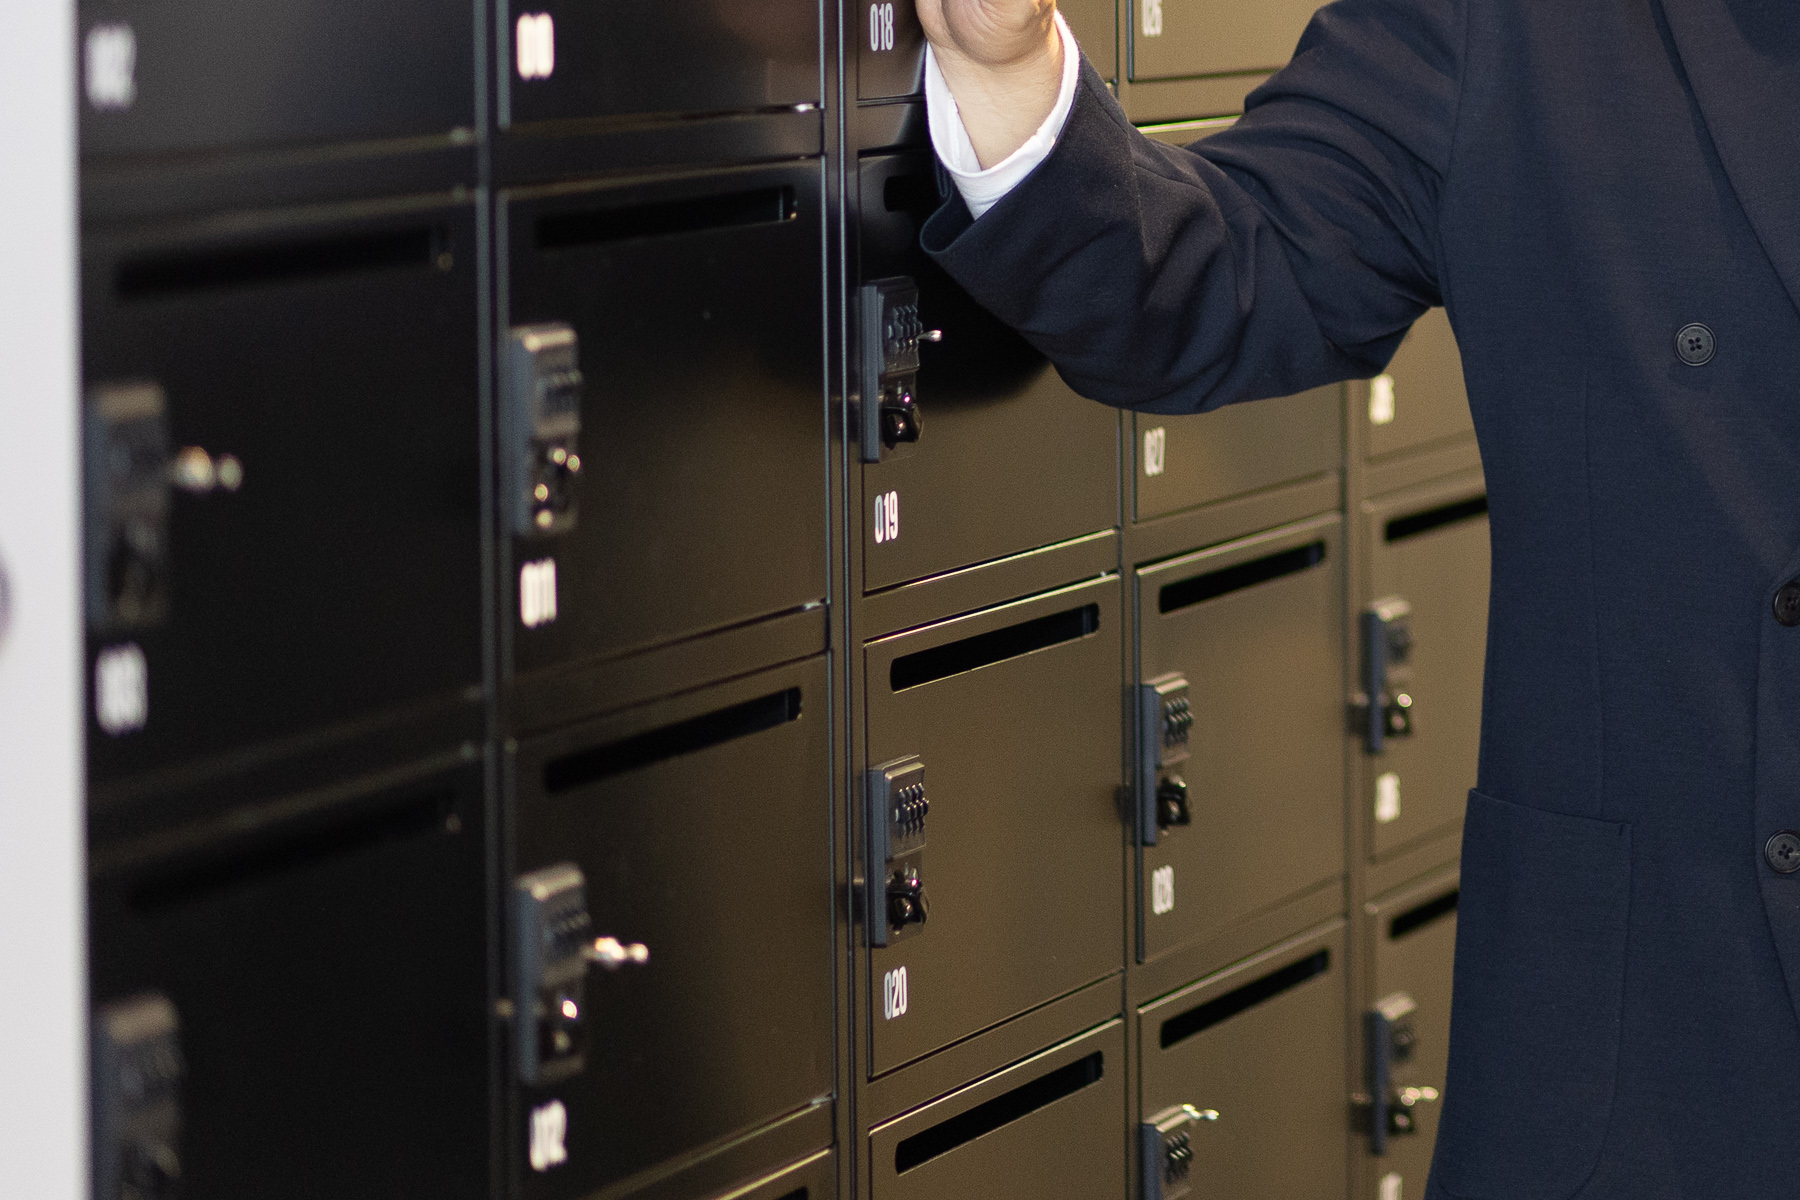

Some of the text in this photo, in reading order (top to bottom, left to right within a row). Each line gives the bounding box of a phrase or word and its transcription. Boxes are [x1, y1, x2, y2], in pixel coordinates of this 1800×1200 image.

[869, 2, 894, 52] 018
[874, 490, 899, 544] 019
[883, 965, 908, 1020] 020
